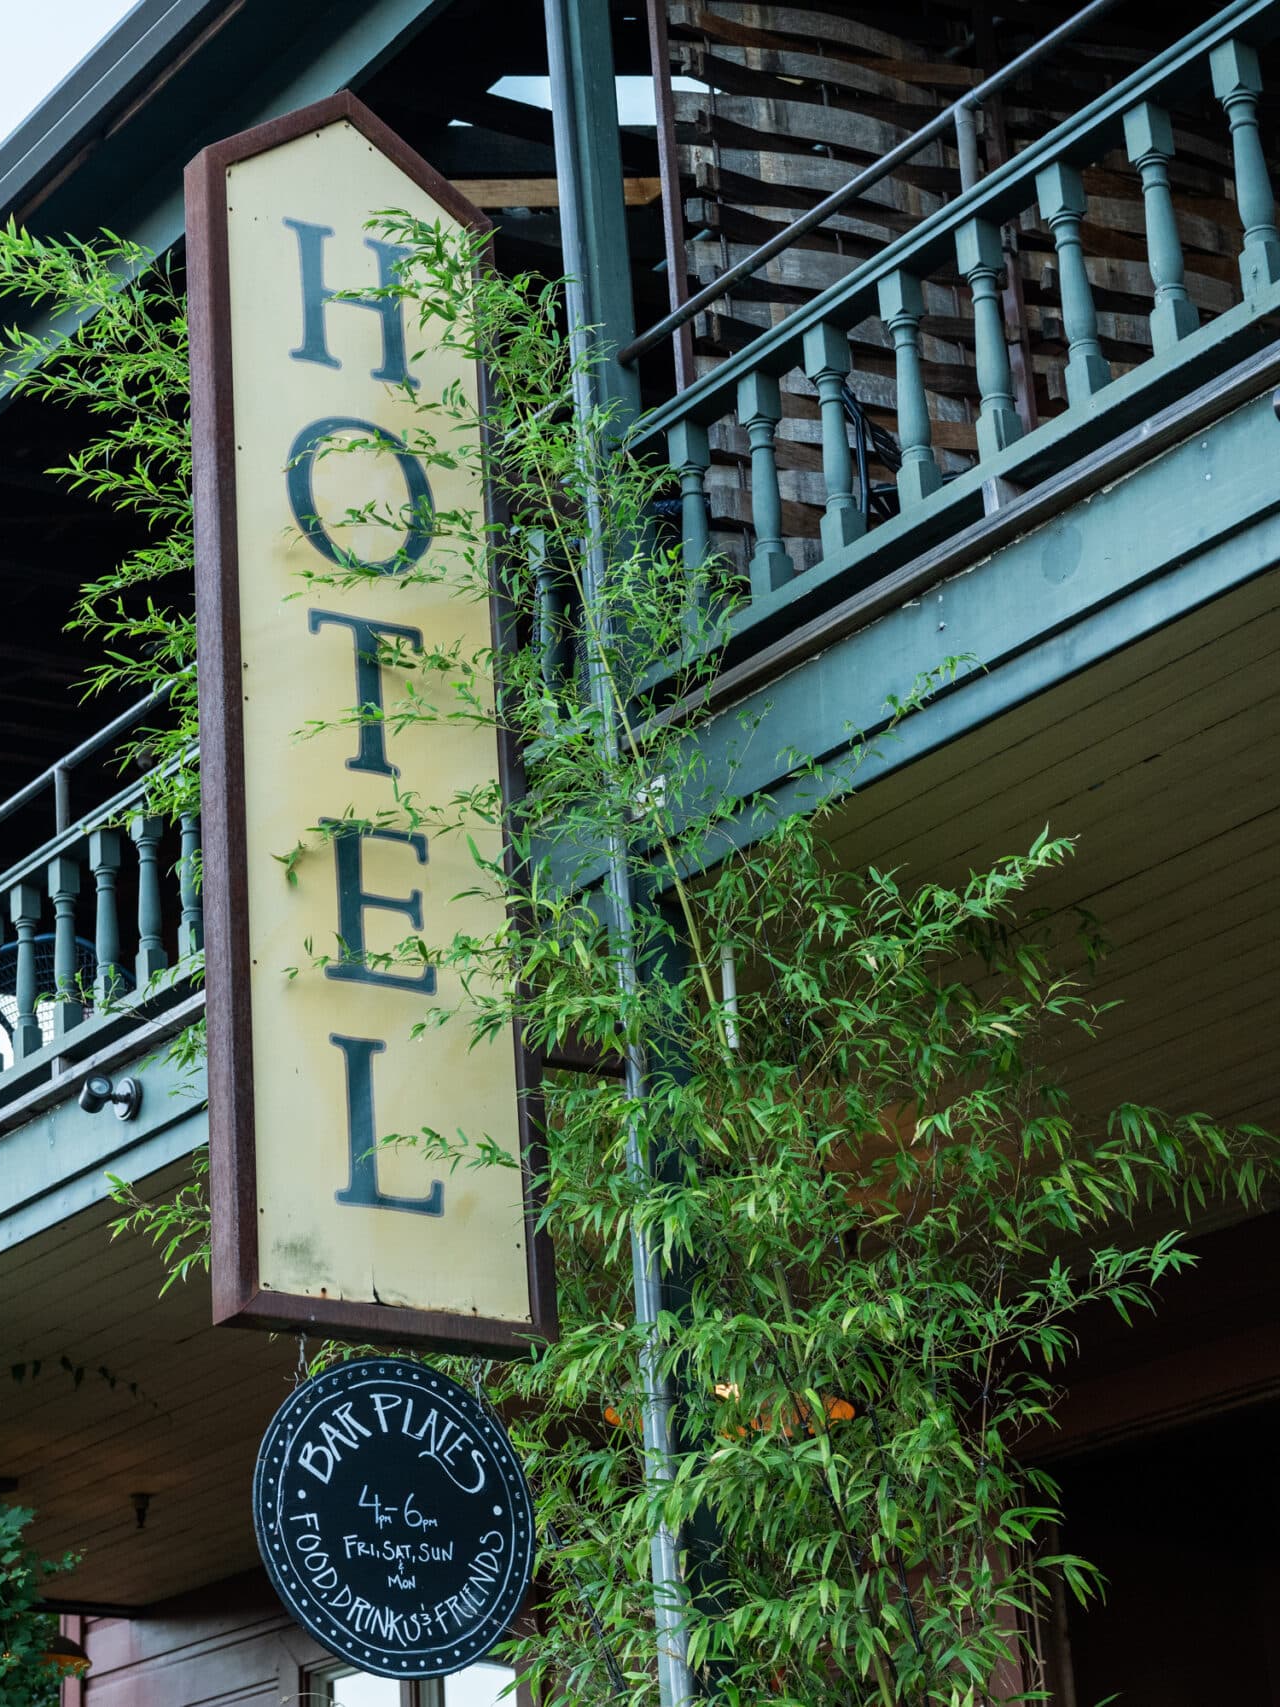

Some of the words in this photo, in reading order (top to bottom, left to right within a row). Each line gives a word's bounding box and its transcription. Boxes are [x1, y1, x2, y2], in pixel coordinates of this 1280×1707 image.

[282, 215, 445, 1219] HOTEL
[297, 1401, 373, 1485] BAR
[369, 1393, 487, 1494] PLATES
[327, 1583, 422, 1648] DRINKS
[432, 1530, 505, 1636] FRIENDS
[418, 1540, 454, 1562] SUN
